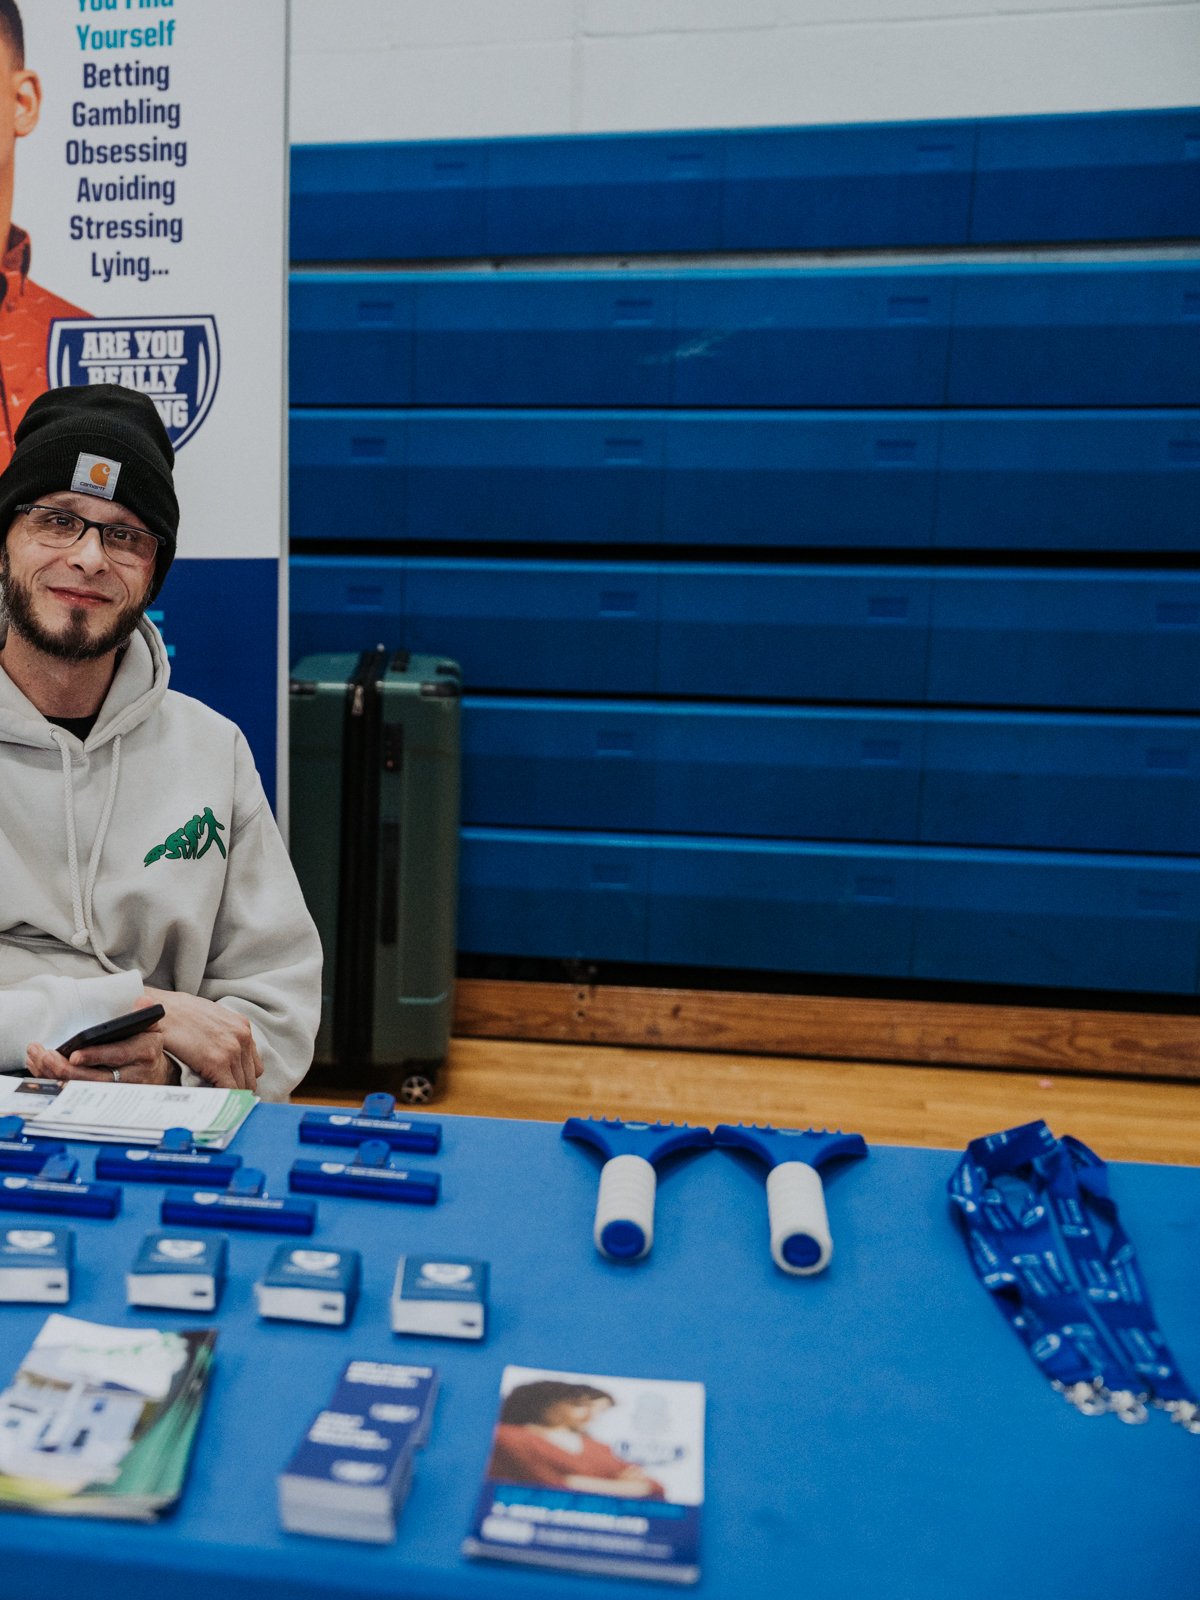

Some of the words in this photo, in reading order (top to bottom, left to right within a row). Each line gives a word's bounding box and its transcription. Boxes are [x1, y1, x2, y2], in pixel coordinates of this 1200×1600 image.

[76, 19, 176, 51] Yourself
[83, 60, 170, 91] Betting
[72, 98, 181, 129] Gambling
[65, 136, 188, 167] Obsessing
[77, 175, 176, 206] Avoiding
[70, 213, 183, 243] Stressing
[91, 251, 169, 283] Lying...
[81, 331, 131, 360] ARE
[134, 329, 185, 359] YOU
[87, 365, 180, 393] REALLY
